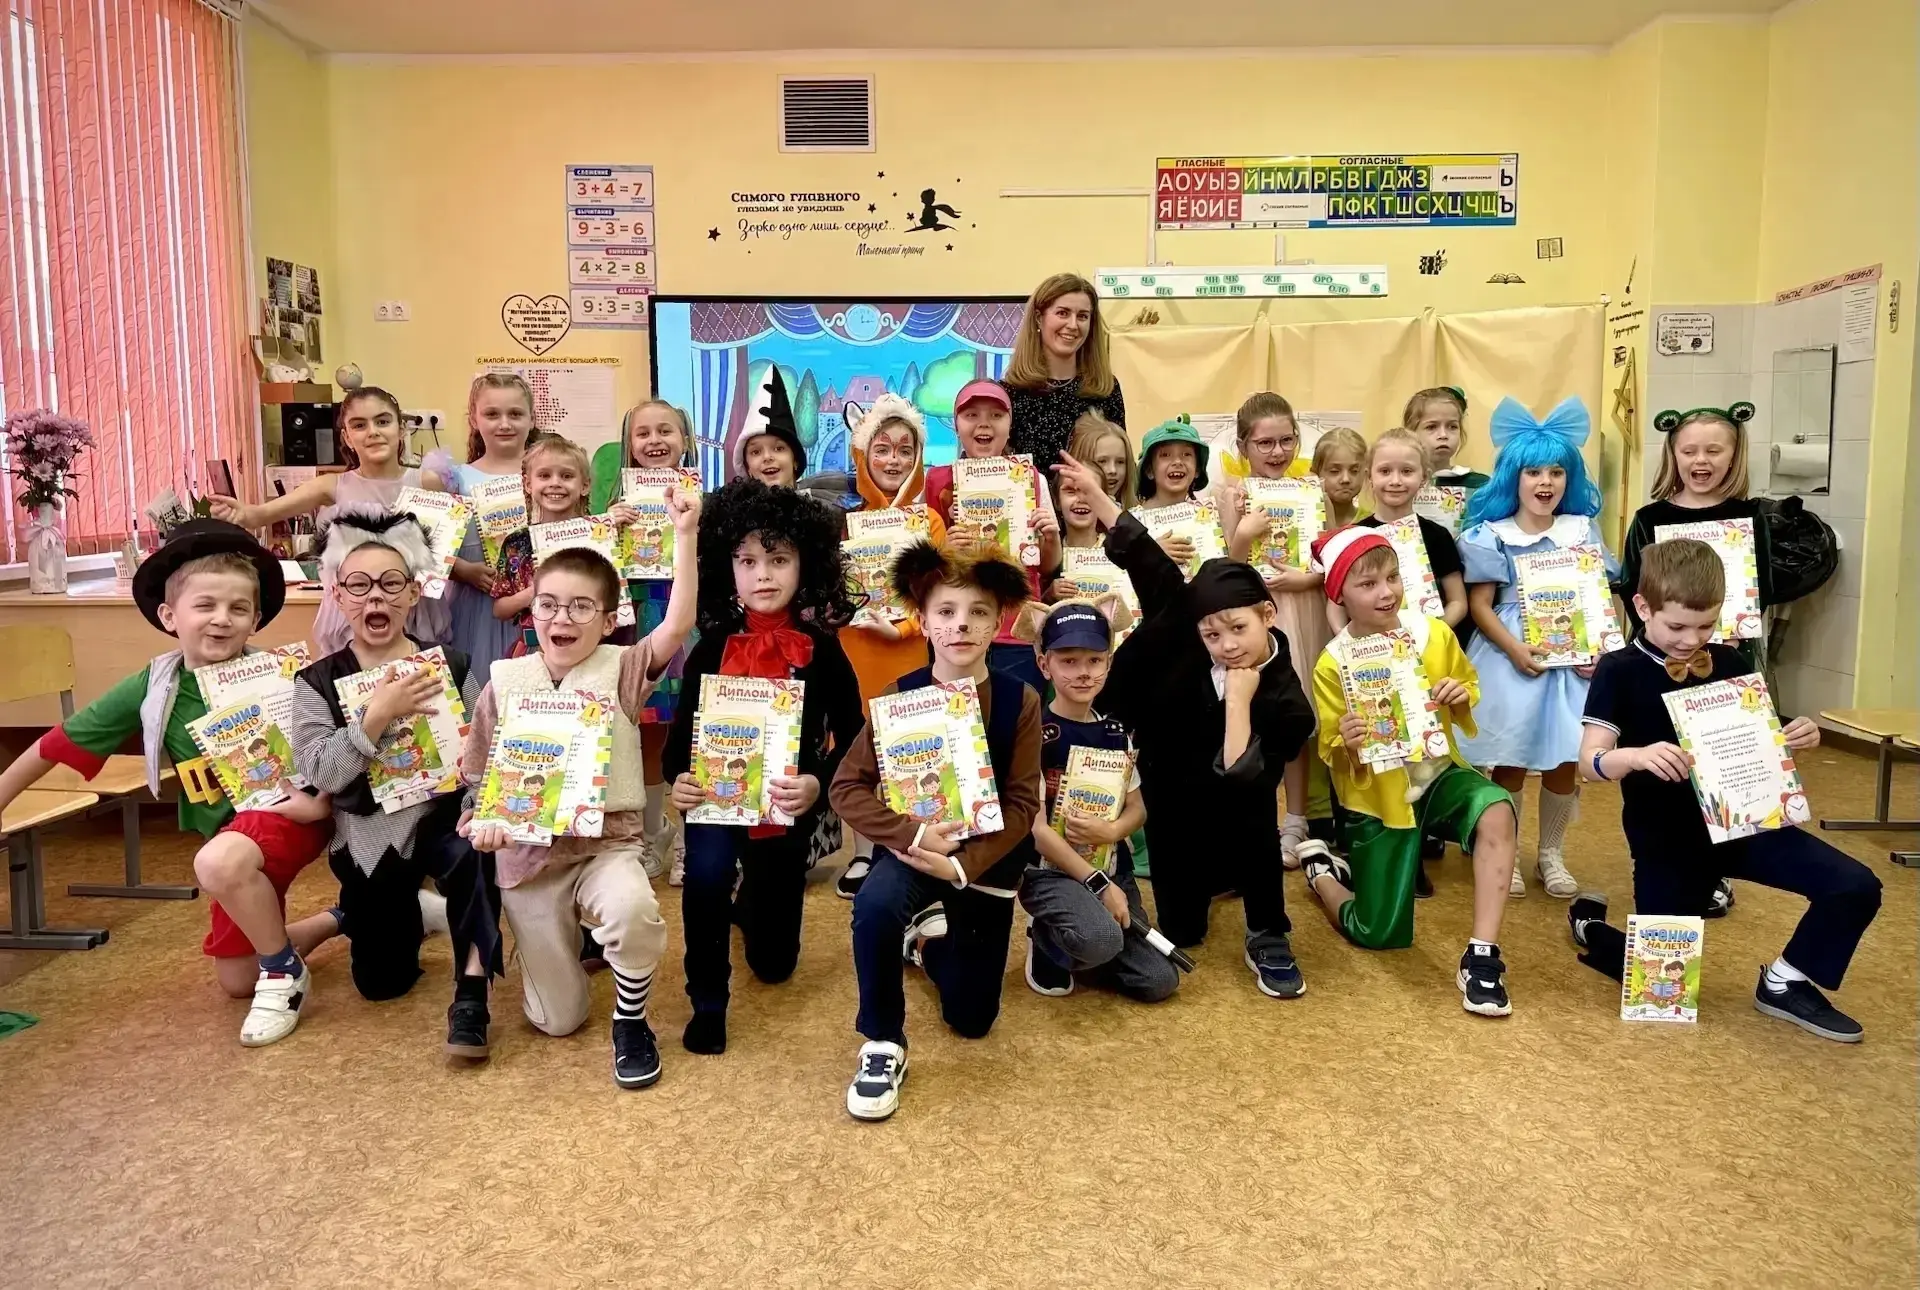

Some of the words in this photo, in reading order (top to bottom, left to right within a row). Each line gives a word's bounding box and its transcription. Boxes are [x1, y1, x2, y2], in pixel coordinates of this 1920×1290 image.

[1176, 159, 1225, 167] ГЛАСНЫЕ
[1339, 157, 1404, 165] СОГЛАСНЫЕ
[1501, 169, 1513, 186] Ь
[578, 183, 586, 195] 3
[604, 183, 615, 195] 4
[633, 183, 642, 195] 7
[731, 192, 785, 202] Самого
[790, 192, 861, 202] главного
[737, 204, 779, 213] глазами
[783, 205, 795, 213] не
[797, 205, 845, 213] увидишь
[1499, 195, 1513, 213] Ъ
[578, 222, 588, 234] 9
[606, 222, 614, 234] 3
[634, 223, 643, 235] 6
[738, 218, 778, 241] Зорко
[779, 222, 807, 240] одно
[810, 222, 839, 231] лишь
[580, 261, 590, 273] 4
[608, 262, 616, 274] 2
[635, 262, 645, 274] 8
[1265, 275, 1280, 283] ЖИ
[1314, 275, 1333, 283] ОРО
[1329, 285, 1348, 293] ОЛО
[1778, 288, 1803, 301] СЧАСТЬЕ
[1810, 280, 1835, 293] ЛЮБИТ
[584, 300, 593, 312] 9
[608, 301, 616, 313] 3
[635, 301, 644, 313] 3
[1057, 614, 1096, 624] ПОЛИЦИЯ
[1372, 680, 1388, 688] ЛЕТО
[217, 733, 233, 743] НА
[235, 718, 259, 736] ЛЕТО
[248, 729, 256, 737] 2
[711, 738, 724, 747] НА
[726, 739, 752, 747] ЛЕТО
[737, 747, 743, 755] 2
[508, 753, 523, 761] НА
[526, 754, 554, 763] ЛЕТО
[897, 755, 910, 765] НА
[914, 750, 939, 765] ЛЕТО
[1647, 941, 1661, 949] НА
[1664, 942, 1690, 950] ЛЕТО
